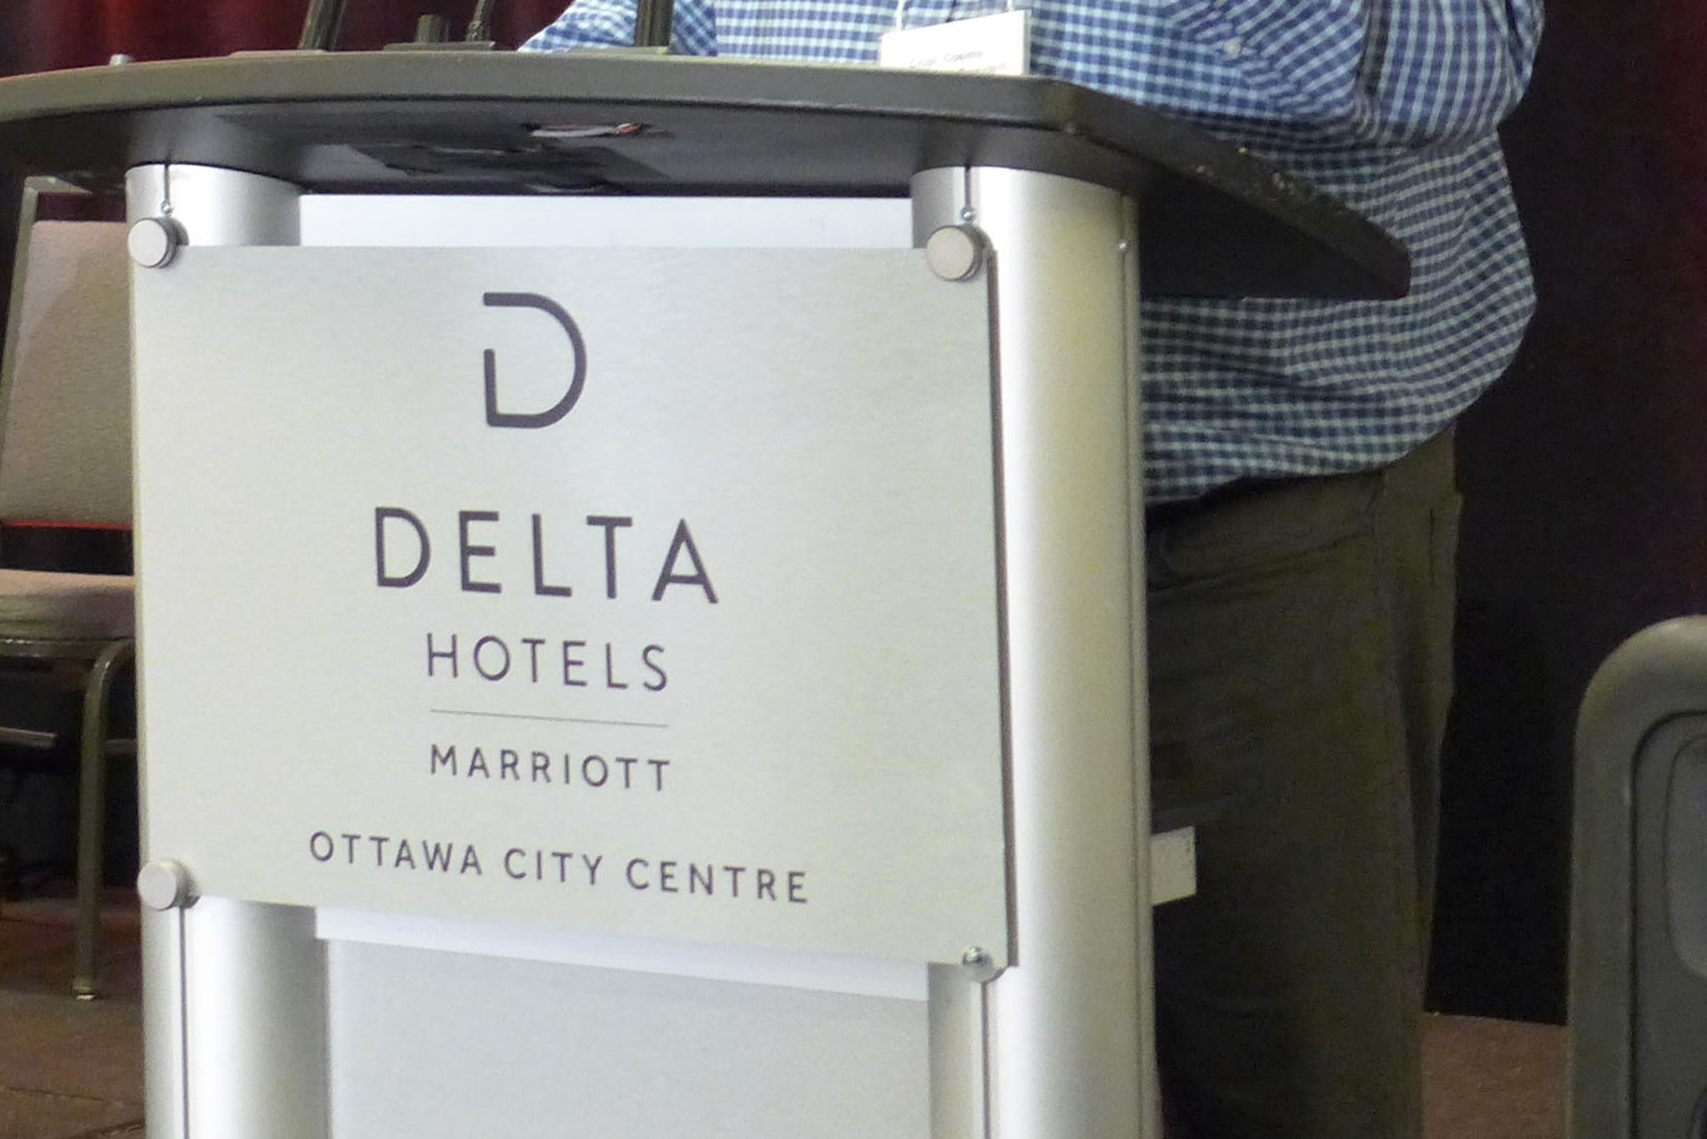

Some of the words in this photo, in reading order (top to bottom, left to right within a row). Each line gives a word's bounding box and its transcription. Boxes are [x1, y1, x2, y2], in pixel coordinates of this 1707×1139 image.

[482, 291, 587, 430] D
[374, 506, 719, 605] DELTA
[426, 632, 668, 692] HOTELS
[430, 744, 671, 792] MARRIOTT
[309, 831, 482, 876] OTTAWA
[504, 847, 603, 886] CITY
[625, 858, 809, 904] CENTRE
